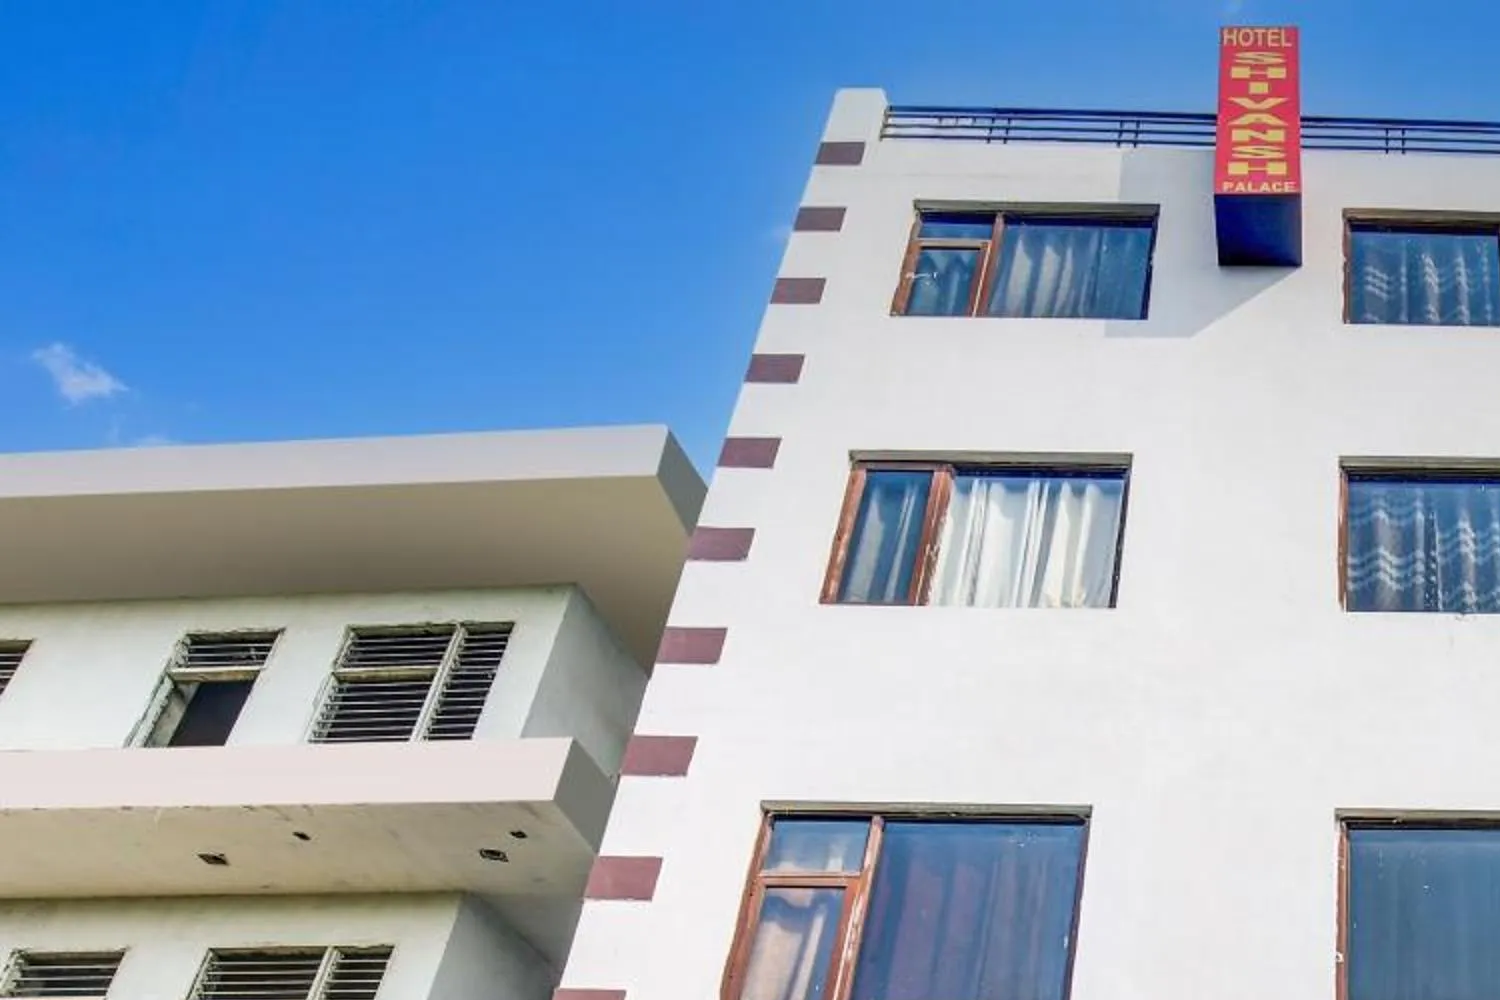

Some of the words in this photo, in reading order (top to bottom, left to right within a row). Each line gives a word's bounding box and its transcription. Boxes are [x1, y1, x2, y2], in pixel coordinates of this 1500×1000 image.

[1222, 28, 1292, 48] HOTEL
[1227, 51, 1289, 175] SHIVANSH
[1222, 181, 1297, 193] PALACE
